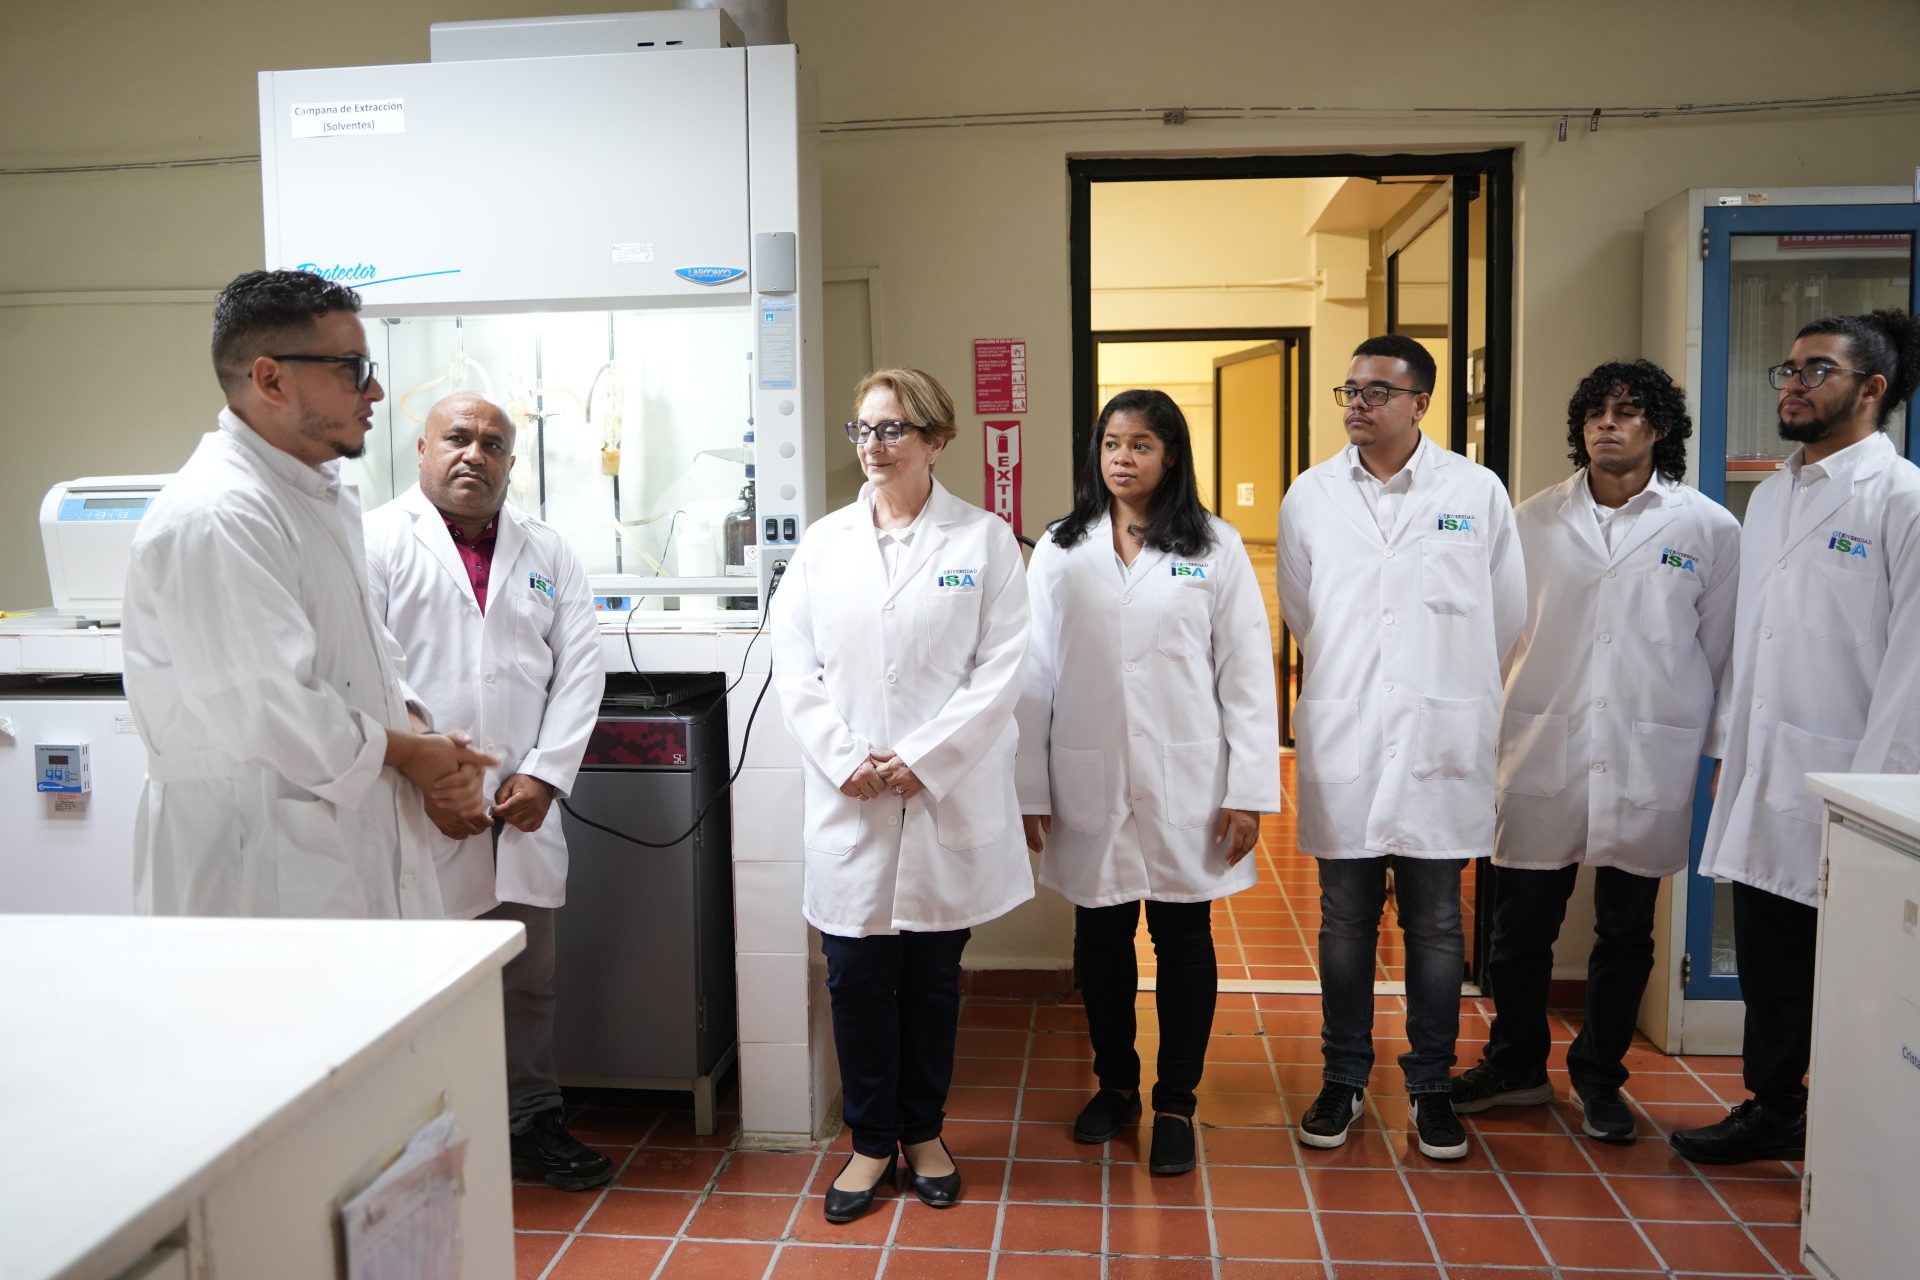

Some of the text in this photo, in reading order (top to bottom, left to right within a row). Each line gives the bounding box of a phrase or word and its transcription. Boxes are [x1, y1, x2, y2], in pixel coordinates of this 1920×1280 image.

[294, 101, 403, 117] Campana de Extracción
[323, 119, 375, 133] (Solventes)
[296, 262, 377, 281] Protector
[687, 268, 732, 278] LABCONCO
[1438, 519, 1473, 532] ISA
[1828, 537, 1867, 558] ISA
[1661, 553, 1695, 573] ISA
[1171, 566, 1206, 579] ISA
[938, 574, 976, 587] ISA
